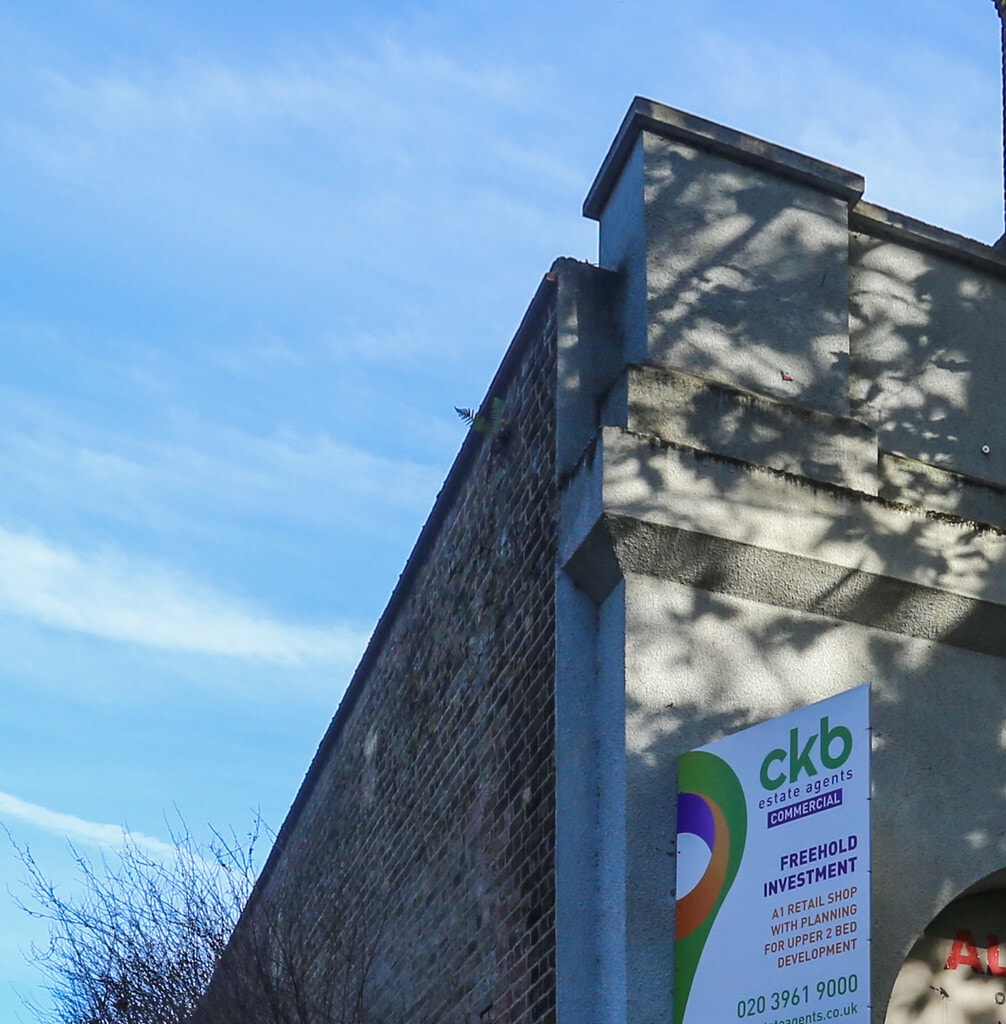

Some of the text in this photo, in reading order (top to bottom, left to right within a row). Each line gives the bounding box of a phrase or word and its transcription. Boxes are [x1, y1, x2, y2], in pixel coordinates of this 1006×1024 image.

[760, 716, 853, 791] ckb
[758, 769, 853, 809] estate agents
[770, 792, 841, 824] COMMERCIAL
[780, 835, 858, 871] FREEHOLD
[763, 857, 858, 897] INVESTMENT
[771, 904, 857, 936] WITH PLANNING
[772, 886, 858, 920] A1 RETAIL SHOP
[764, 921, 857, 955] FOR UPPER 2 BED
[778, 938, 858, 968] DEVELOPMENT
[737, 974, 858, 1018] 020 3961 9000
